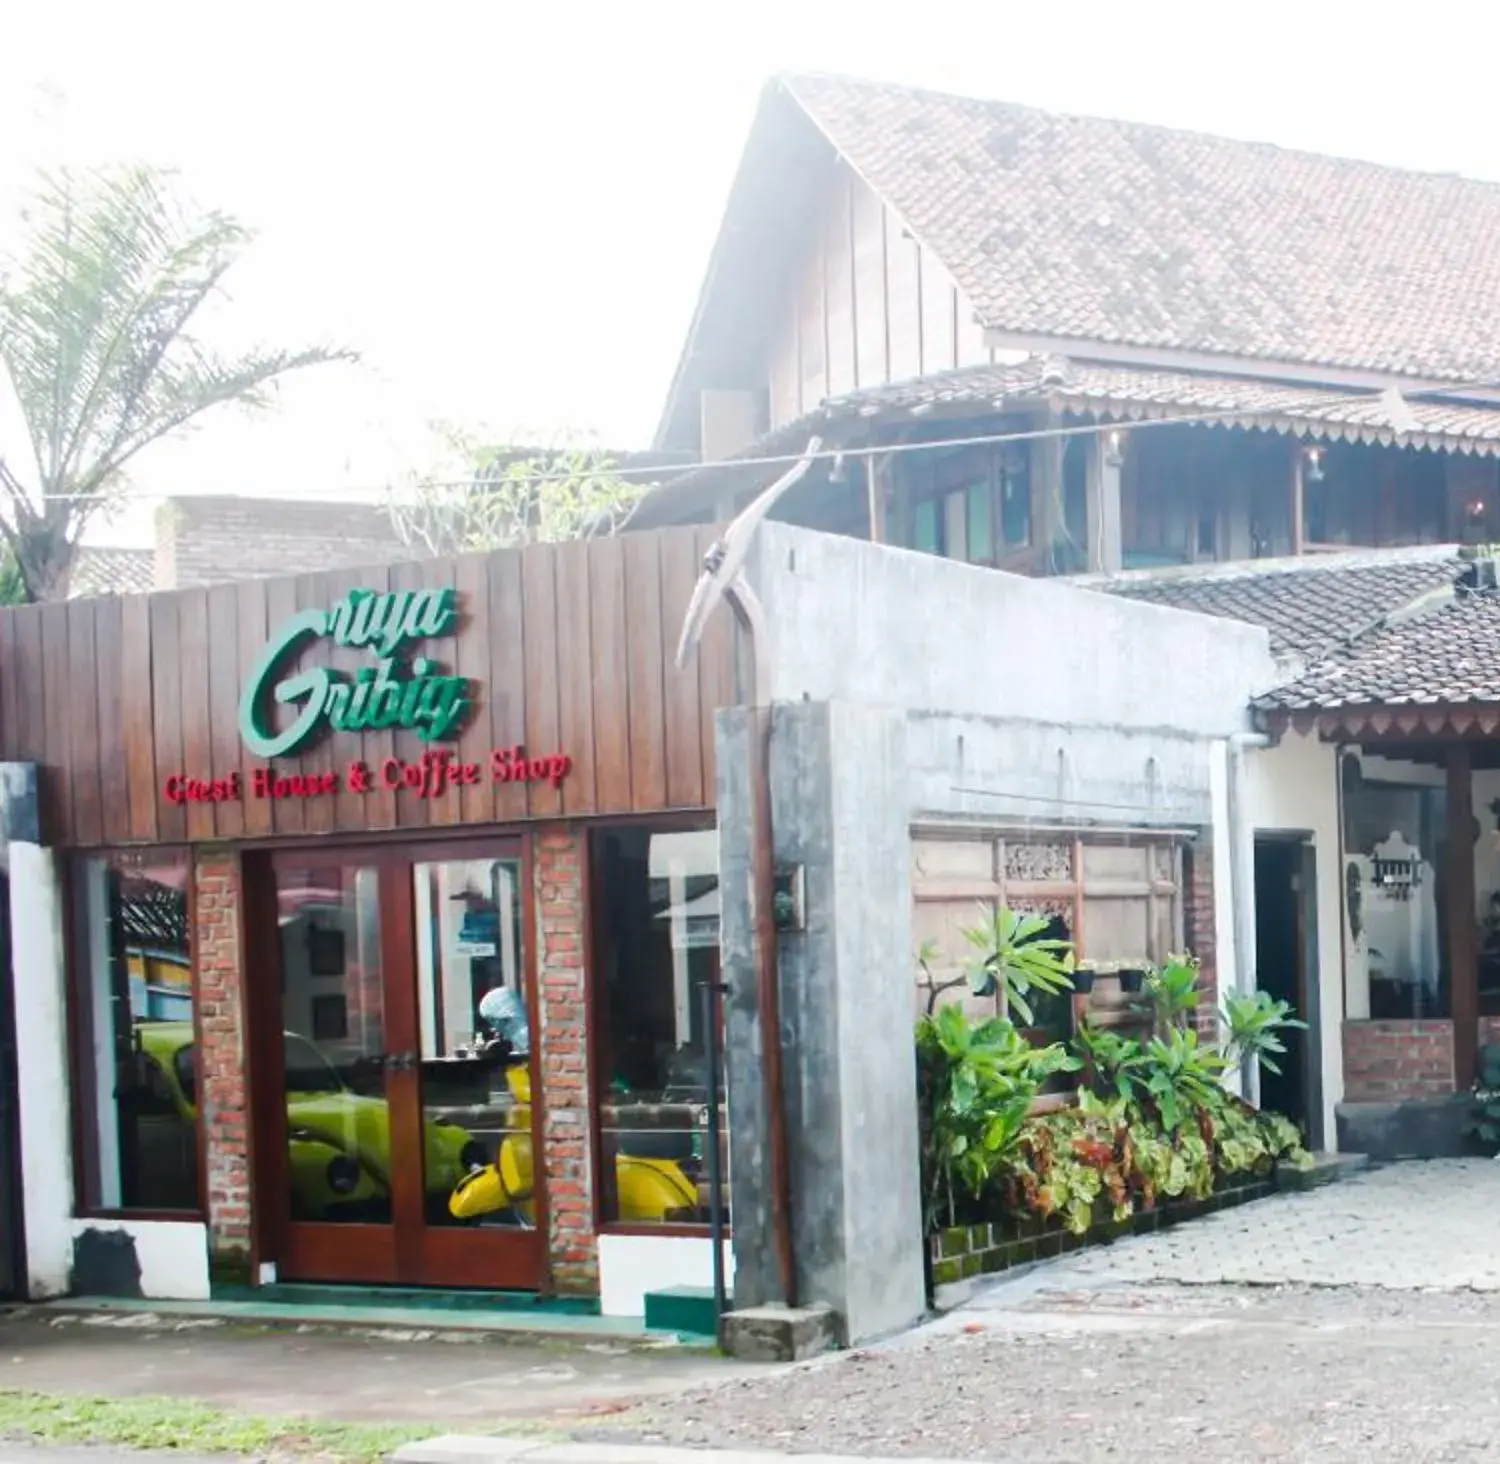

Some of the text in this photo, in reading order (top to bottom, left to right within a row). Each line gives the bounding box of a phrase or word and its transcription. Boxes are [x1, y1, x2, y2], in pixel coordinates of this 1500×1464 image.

[164, 746, 572, 804] Guest House & Coffee Shop
